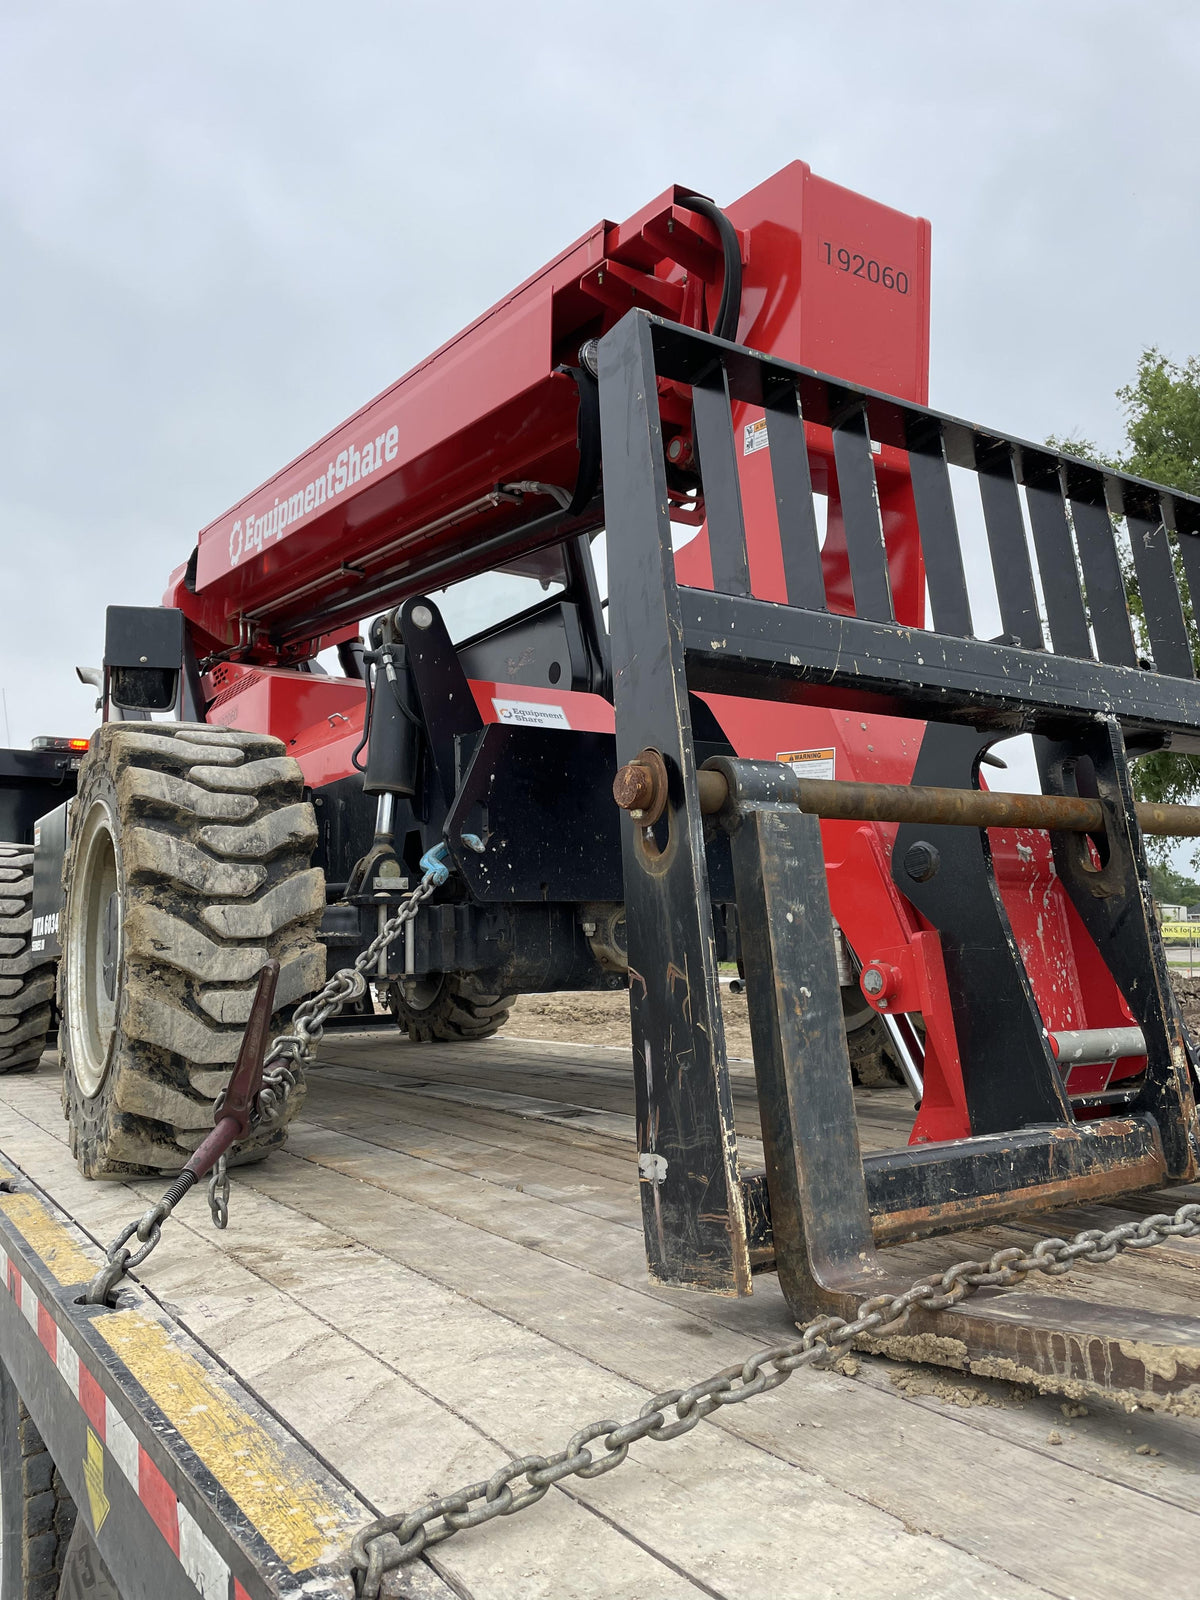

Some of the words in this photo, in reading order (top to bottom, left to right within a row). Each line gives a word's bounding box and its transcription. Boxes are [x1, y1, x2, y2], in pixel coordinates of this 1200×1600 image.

[823, 242, 908, 294] 192060
[244, 425, 399, 552] EquipmentShare
[512, 707, 564, 720] Equipment
[515, 714, 543, 724] Share
[795, 752, 822, 760] WARNING
